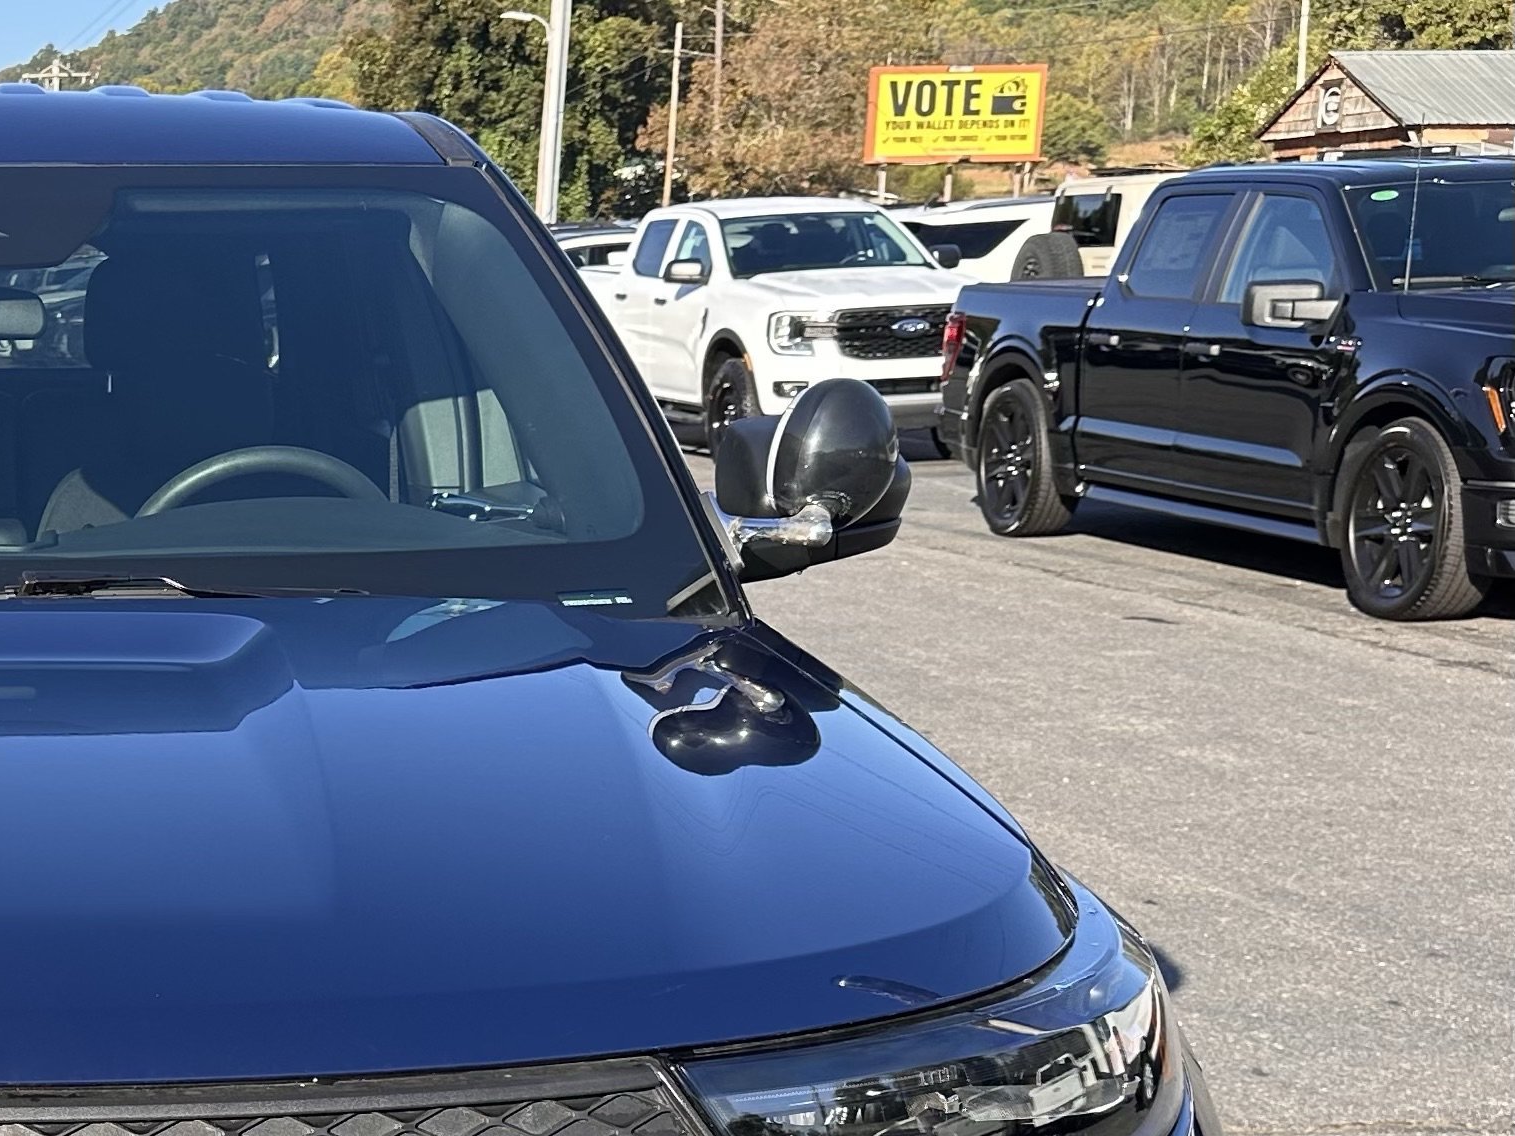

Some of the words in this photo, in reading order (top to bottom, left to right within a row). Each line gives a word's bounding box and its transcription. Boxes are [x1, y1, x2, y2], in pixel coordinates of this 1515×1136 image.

[889, 79, 983, 117] VOTE
[885, 120, 911, 130] YOUR
[916, 120, 954, 130] WALLET
[958, 119, 1000, 130] DEPENDS
